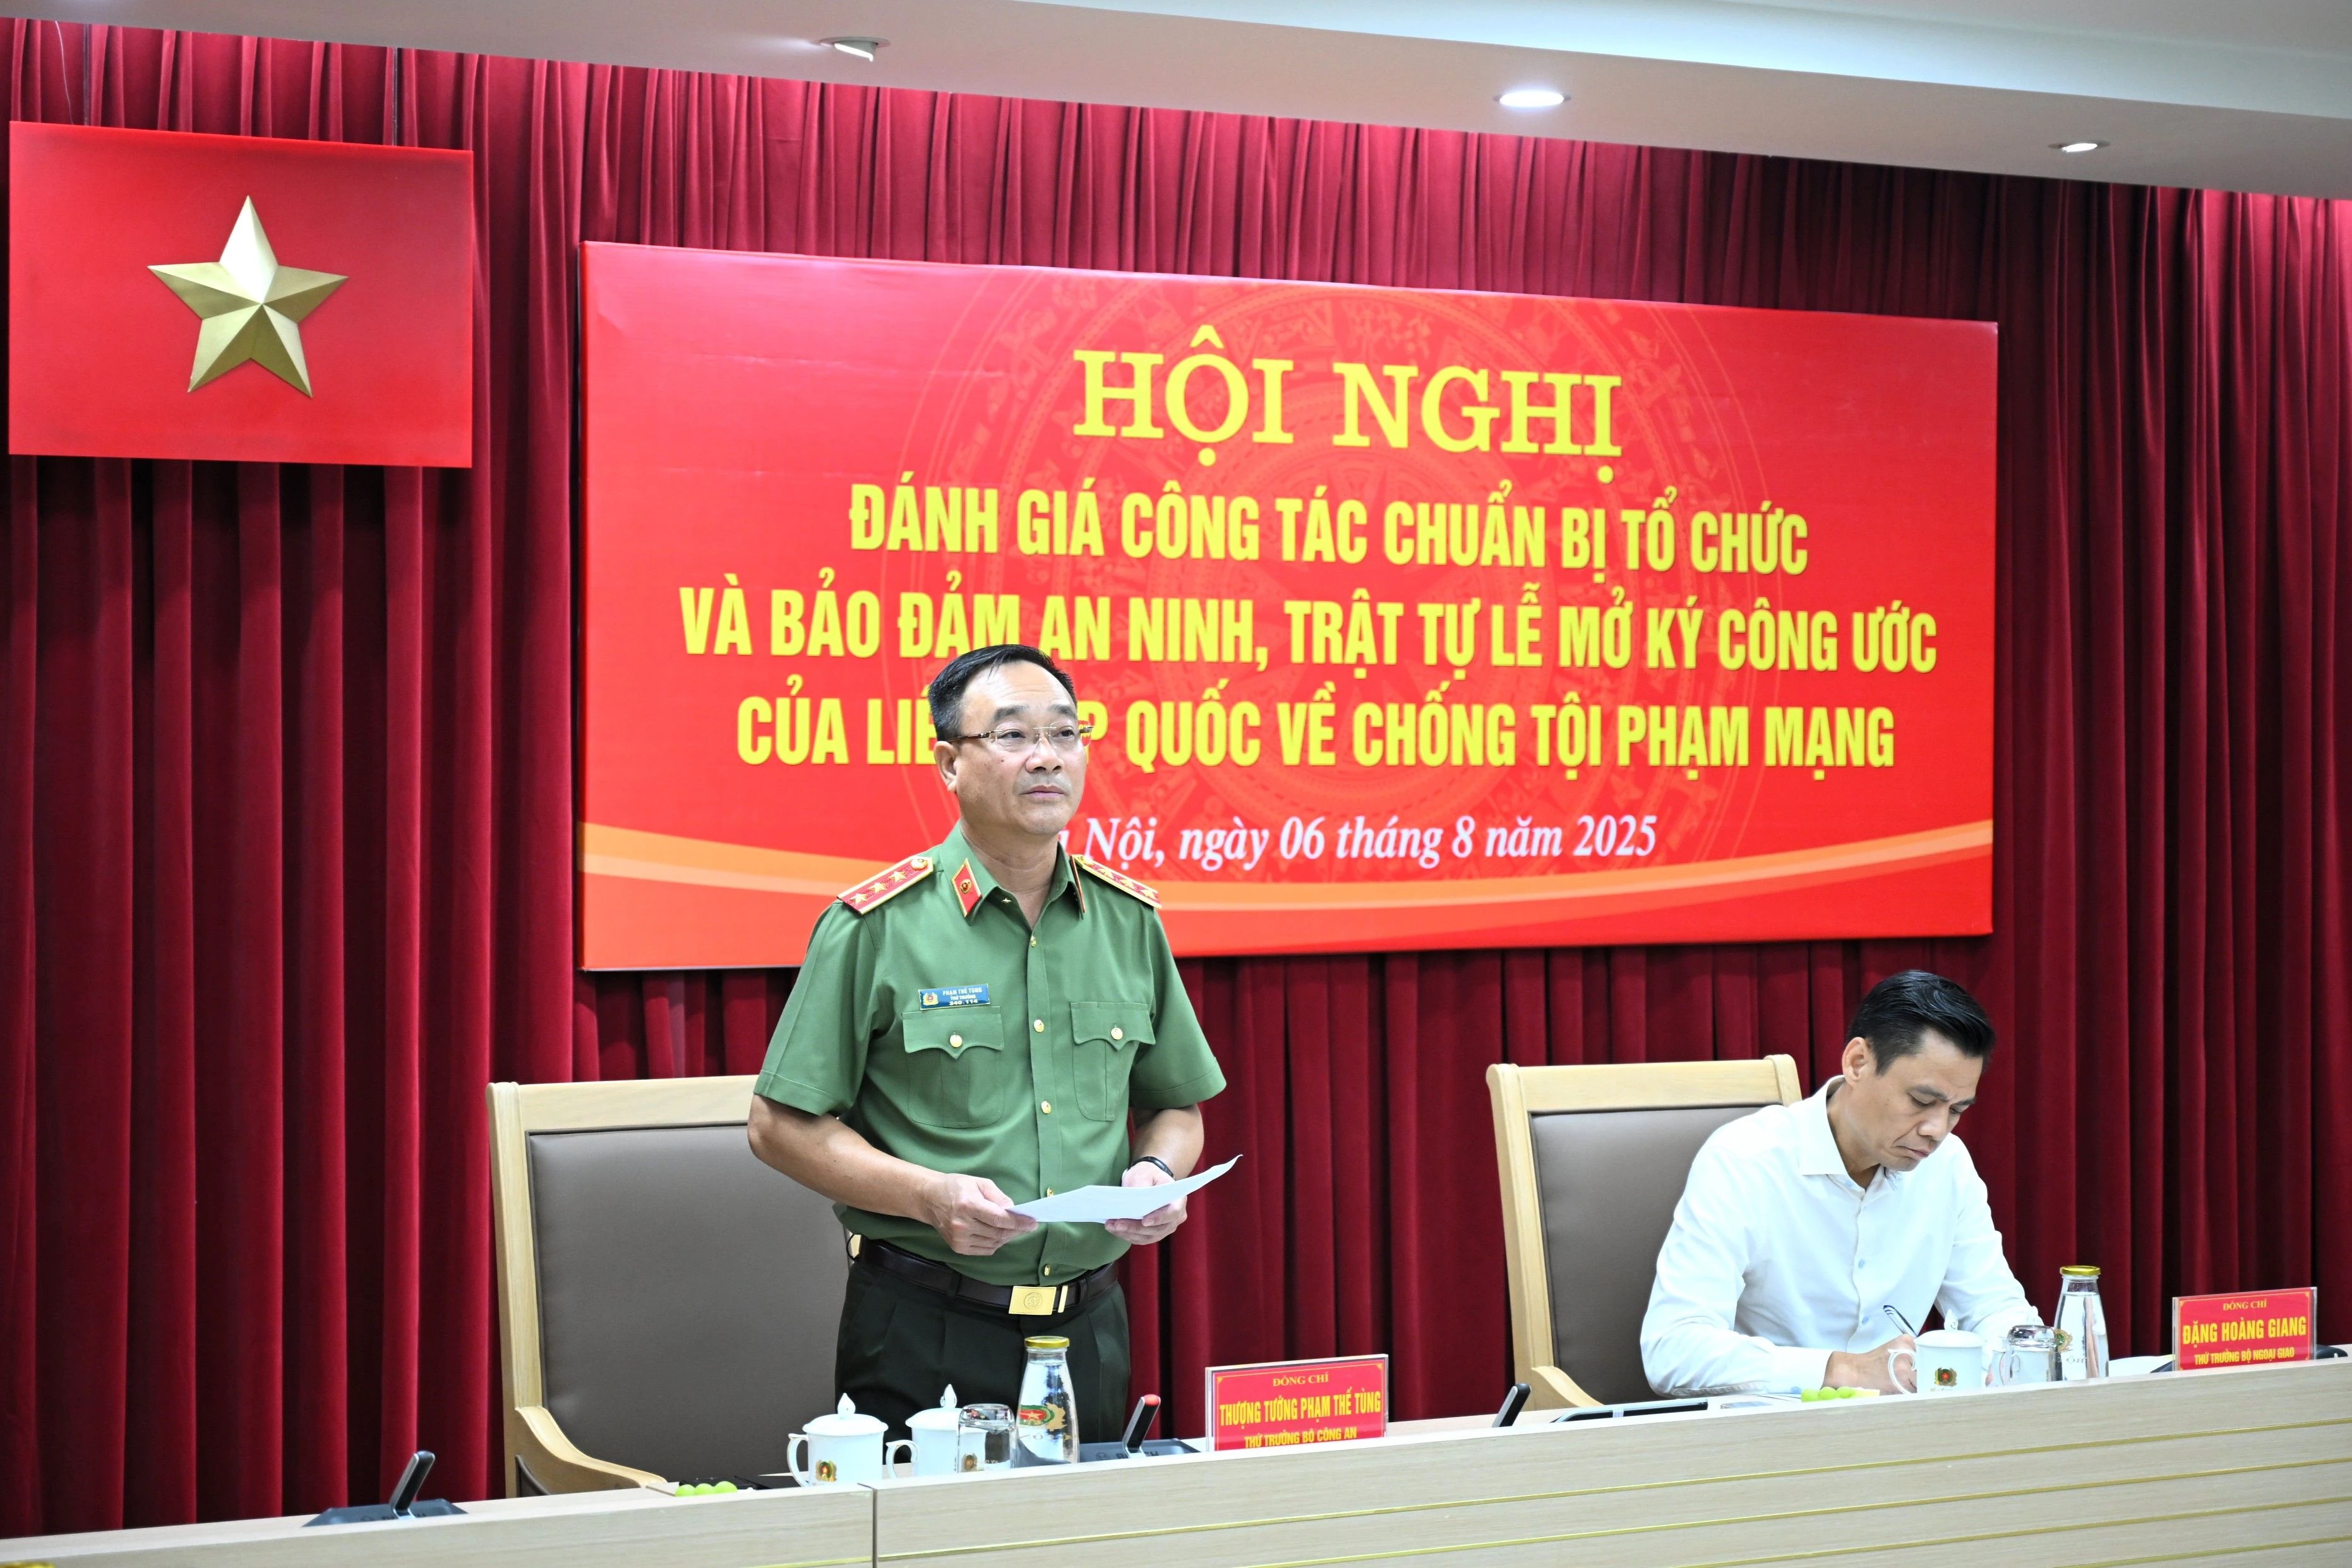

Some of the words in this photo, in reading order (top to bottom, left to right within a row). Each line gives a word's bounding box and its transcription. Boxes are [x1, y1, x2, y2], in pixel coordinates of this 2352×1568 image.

[1072, 323, 1295, 467] HỘI
[1331, 361, 1623, 484] NGHỊ
[848, 470, 999, 554] ĐÁNH
[1016, 476, 1105, 557] GIÁ
[1120, 479, 1260, 561] CÔNG
[1274, 484, 1368, 565] TÁC
[1383, 478, 1546, 568] CHUẨN
[1561, 506, 1606, 584] BỊ
[1620, 485, 1677, 572] TỔ
[1690, 500, 1808, 575] CHỨC
[678, 572, 753, 655] VÀ
[770, 566, 881, 659] BẢO
[897, 569, 1021, 659] ĐẢM
[1037, 595, 1111, 661] AN
[1128, 596, 1269, 672] NINH,
[1283, 587, 1405, 679] TRẬT
[1417, 597, 1482, 681] TỰ
[1491, 581, 1543, 667] LỄ
[1559, 585, 1634, 669] MỞ
[1647, 595, 1704, 669] KÝ
[1718, 597, 1838, 672] CÔNG
[1852, 600, 1937, 673] ƯỚC
[736, 673, 849, 765] CỦA
[867, 683, 938, 765] LIÊ
[1125, 678, 1262, 774] QUỐC
[1276, 680, 1336, 766] VỀ
[1352, 680, 1516, 767] CHỐNG
[1530, 690, 1602, 781] TỘI
[1617, 704, 1749, 781] PHẠM
[1765, 706, 1894, 781] MẠNG
[1082, 815, 1165, 871] Nội,
[1179, 816, 1270, 871] ngày
[1279, 816, 1326, 860] 06
[1336, 815, 1444, 870] tháng
[1451, 815, 1476, 858] 8
[1485, 815, 1563, 858] năm
[1573, 815, 1657, 857] 2025
[2250, 1298, 2267, 1308] CHÍ
[2183, 1320, 2218, 1348] ĐẶNG
[2221, 1317, 2264, 1341] HOÀNG
[2268, 1316, 2307, 1339] GIANG
[2194, 1352, 2210, 1365] THỨ
[2211, 1349, 2240, 1364] TRƯỞNG
[2241, 1348, 2252, 1363] BỘ
[2253, 1348, 2276, 1362] NGOẠI
[2277, 1347, 2295, 1358] GIAO
[1308, 1372, 1329, 1384] CHÍ
[1220, 1400, 1261, 1429] THƯỢNG
[1264, 1394, 1297, 1422] TƯỚNG
[1300, 1395, 1331, 1423] PHẠM
[1333, 1386, 1352, 1416] THẾ
[1354, 1387, 1381, 1413] TÙNG
[1244, 1433, 1262, 1449] THỨ
[1264, 1428, 1300, 1447] TRƯỞNG
[1318, 1427, 1341, 1442] CÔNG
[1344, 1427, 1357, 1439] AN
